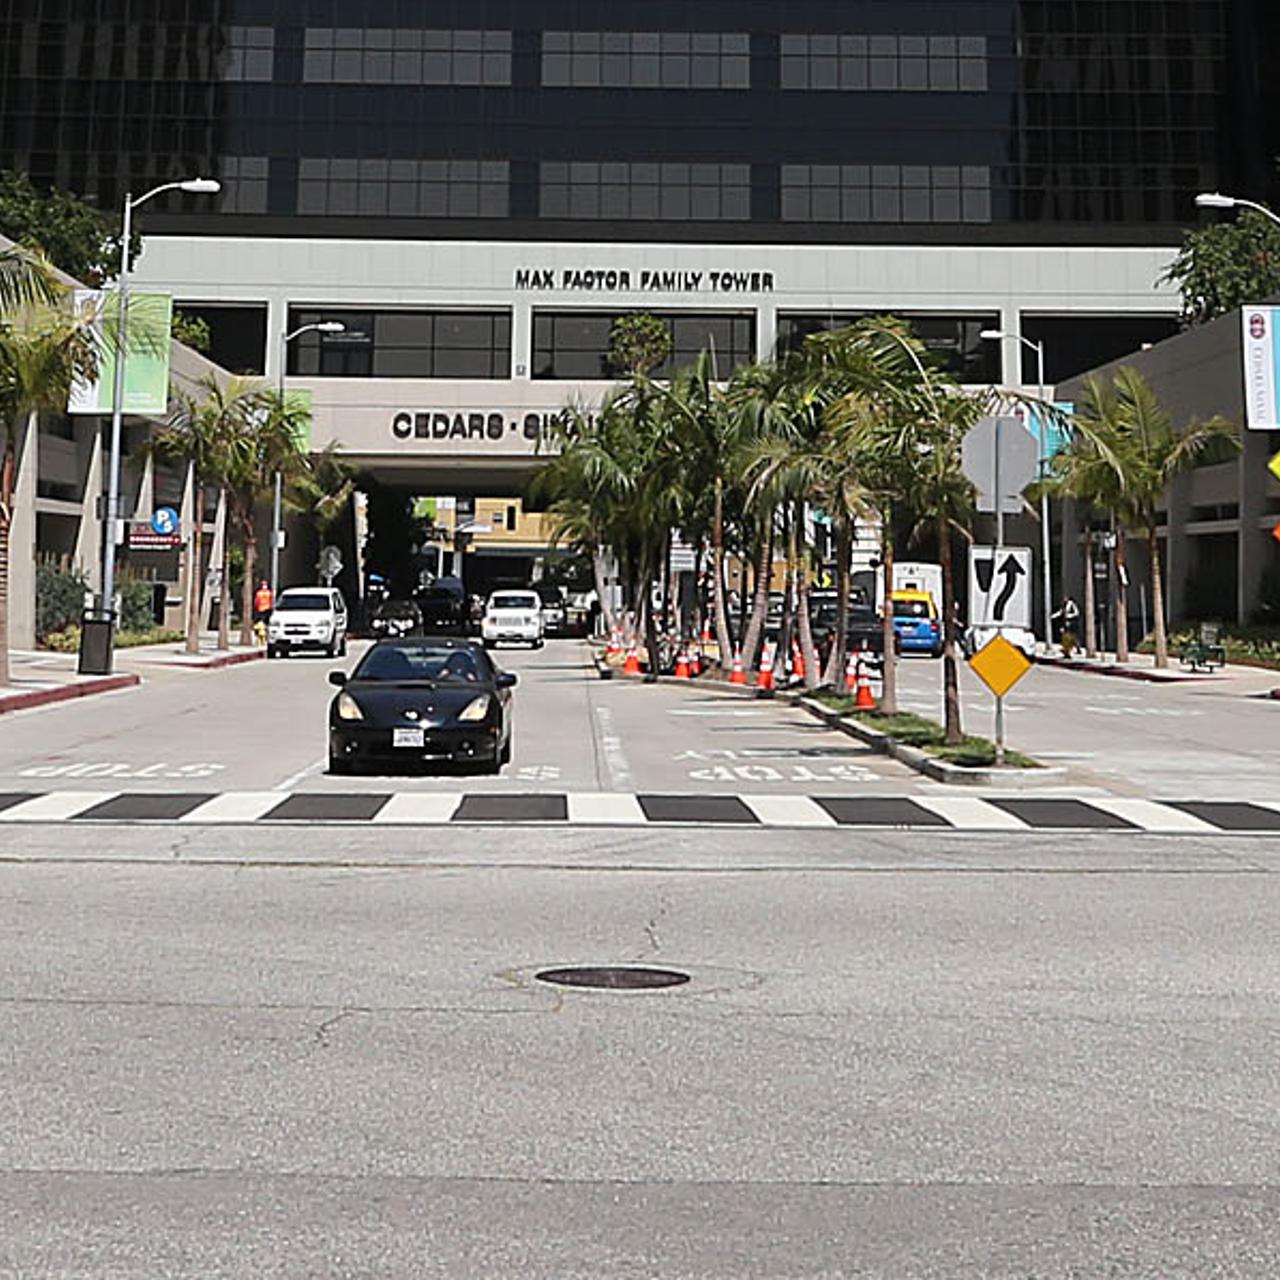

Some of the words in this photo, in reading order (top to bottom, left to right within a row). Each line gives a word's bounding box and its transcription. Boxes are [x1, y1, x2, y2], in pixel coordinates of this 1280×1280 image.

[515, 270, 554, 290] MAX
[563, 270, 630, 290] FACTOR
[640, 271, 702, 291] FAMILY
[709, 272, 774, 292] TOWER
[392, 412, 504, 440] CEDARS
[689, 764, 881, 782] STOP
